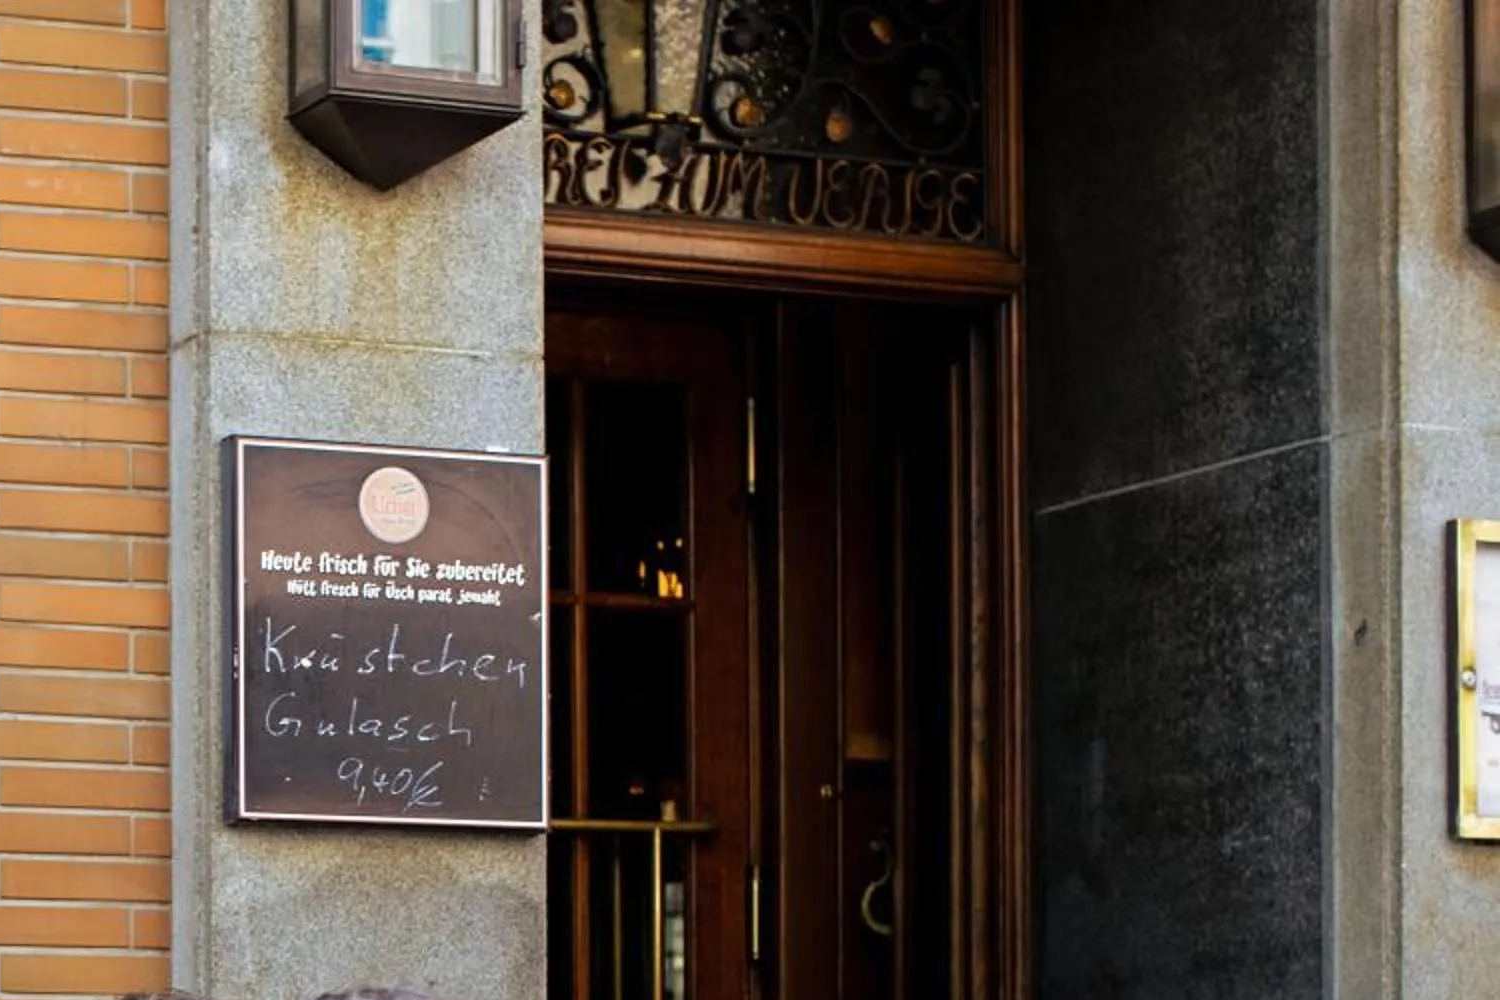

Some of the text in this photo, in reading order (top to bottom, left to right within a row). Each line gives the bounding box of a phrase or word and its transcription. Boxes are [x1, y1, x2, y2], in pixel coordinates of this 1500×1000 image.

[261, 550, 525, 587] Heute frisch für Sie zubereitet
[265, 692, 470, 747] Gulasch
[337, 757, 443, 811] 9,40€
